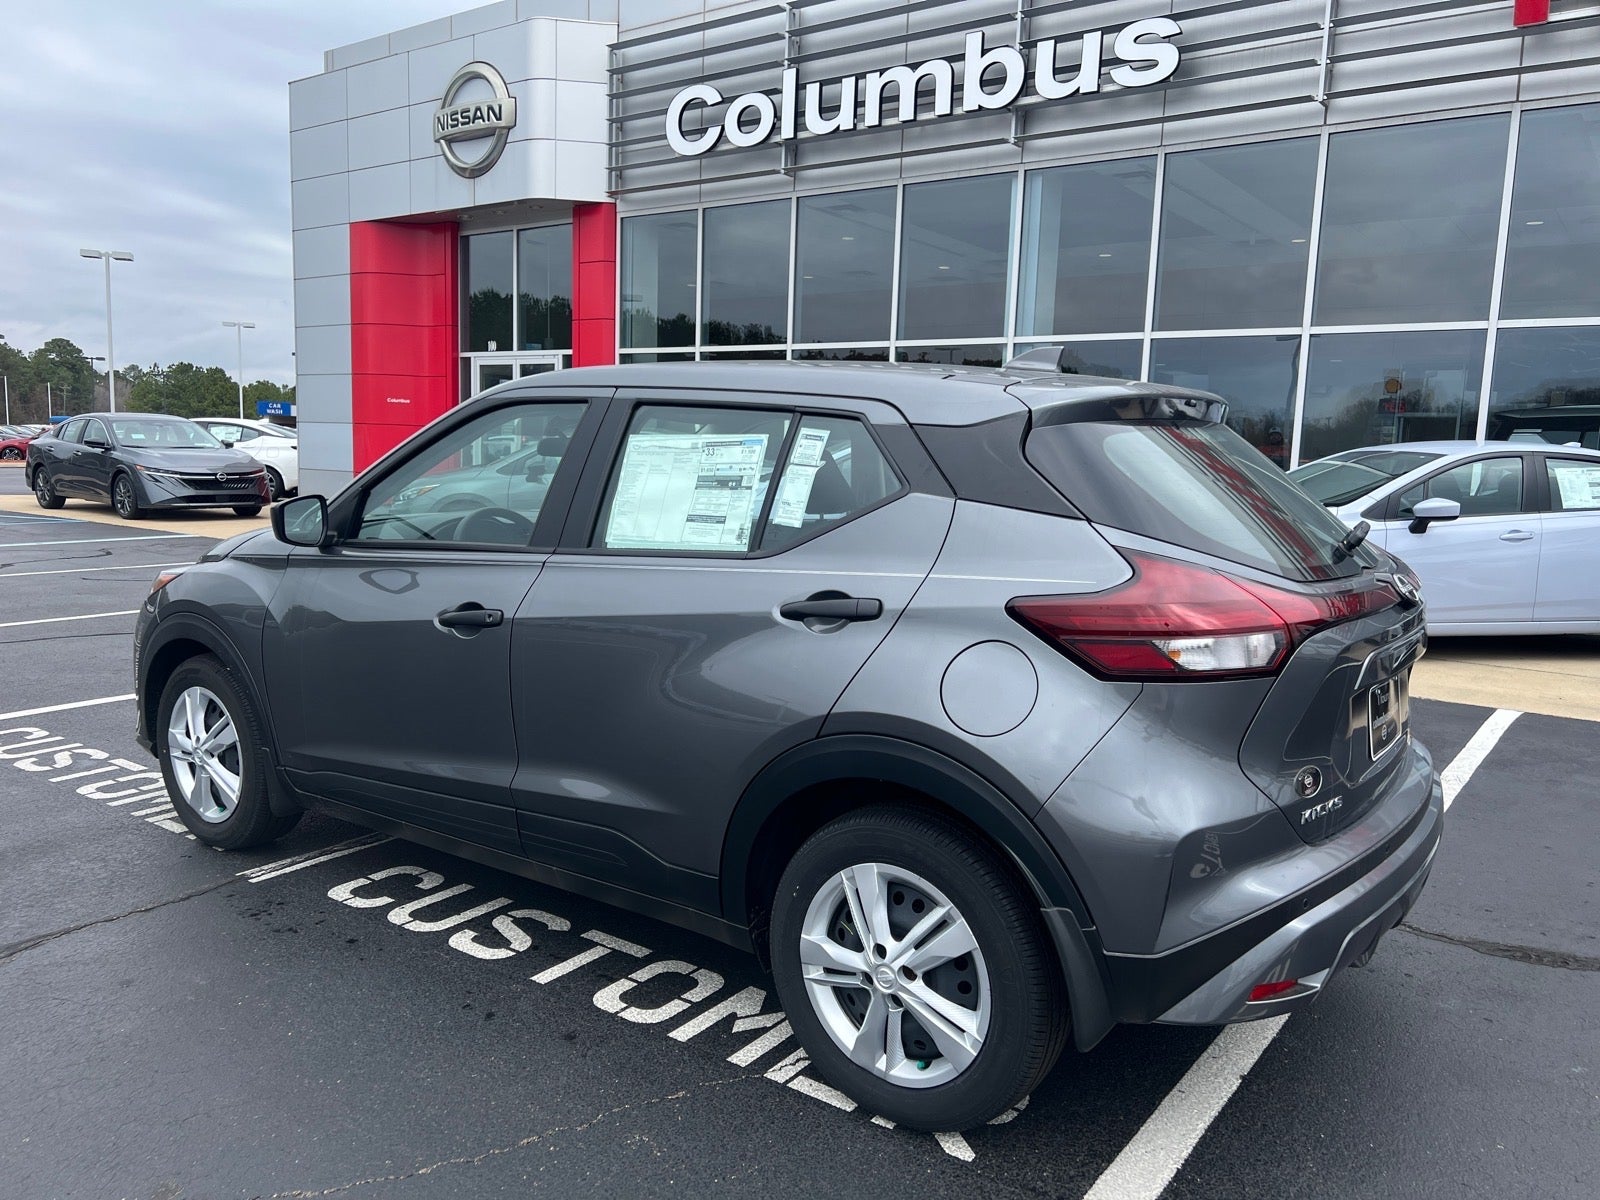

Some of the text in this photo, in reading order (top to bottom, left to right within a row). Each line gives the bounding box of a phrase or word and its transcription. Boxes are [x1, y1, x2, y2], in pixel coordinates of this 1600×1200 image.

[436, 103, 503, 133] NISSAN
[664, 16, 1184, 157] Columbus
[705, 447, 716, 457] 33
[0, 727, 200, 842] CUSTOM
[1300, 796, 1344, 825] KICKS
[327, 865, 976, 1163] CUSTOM
